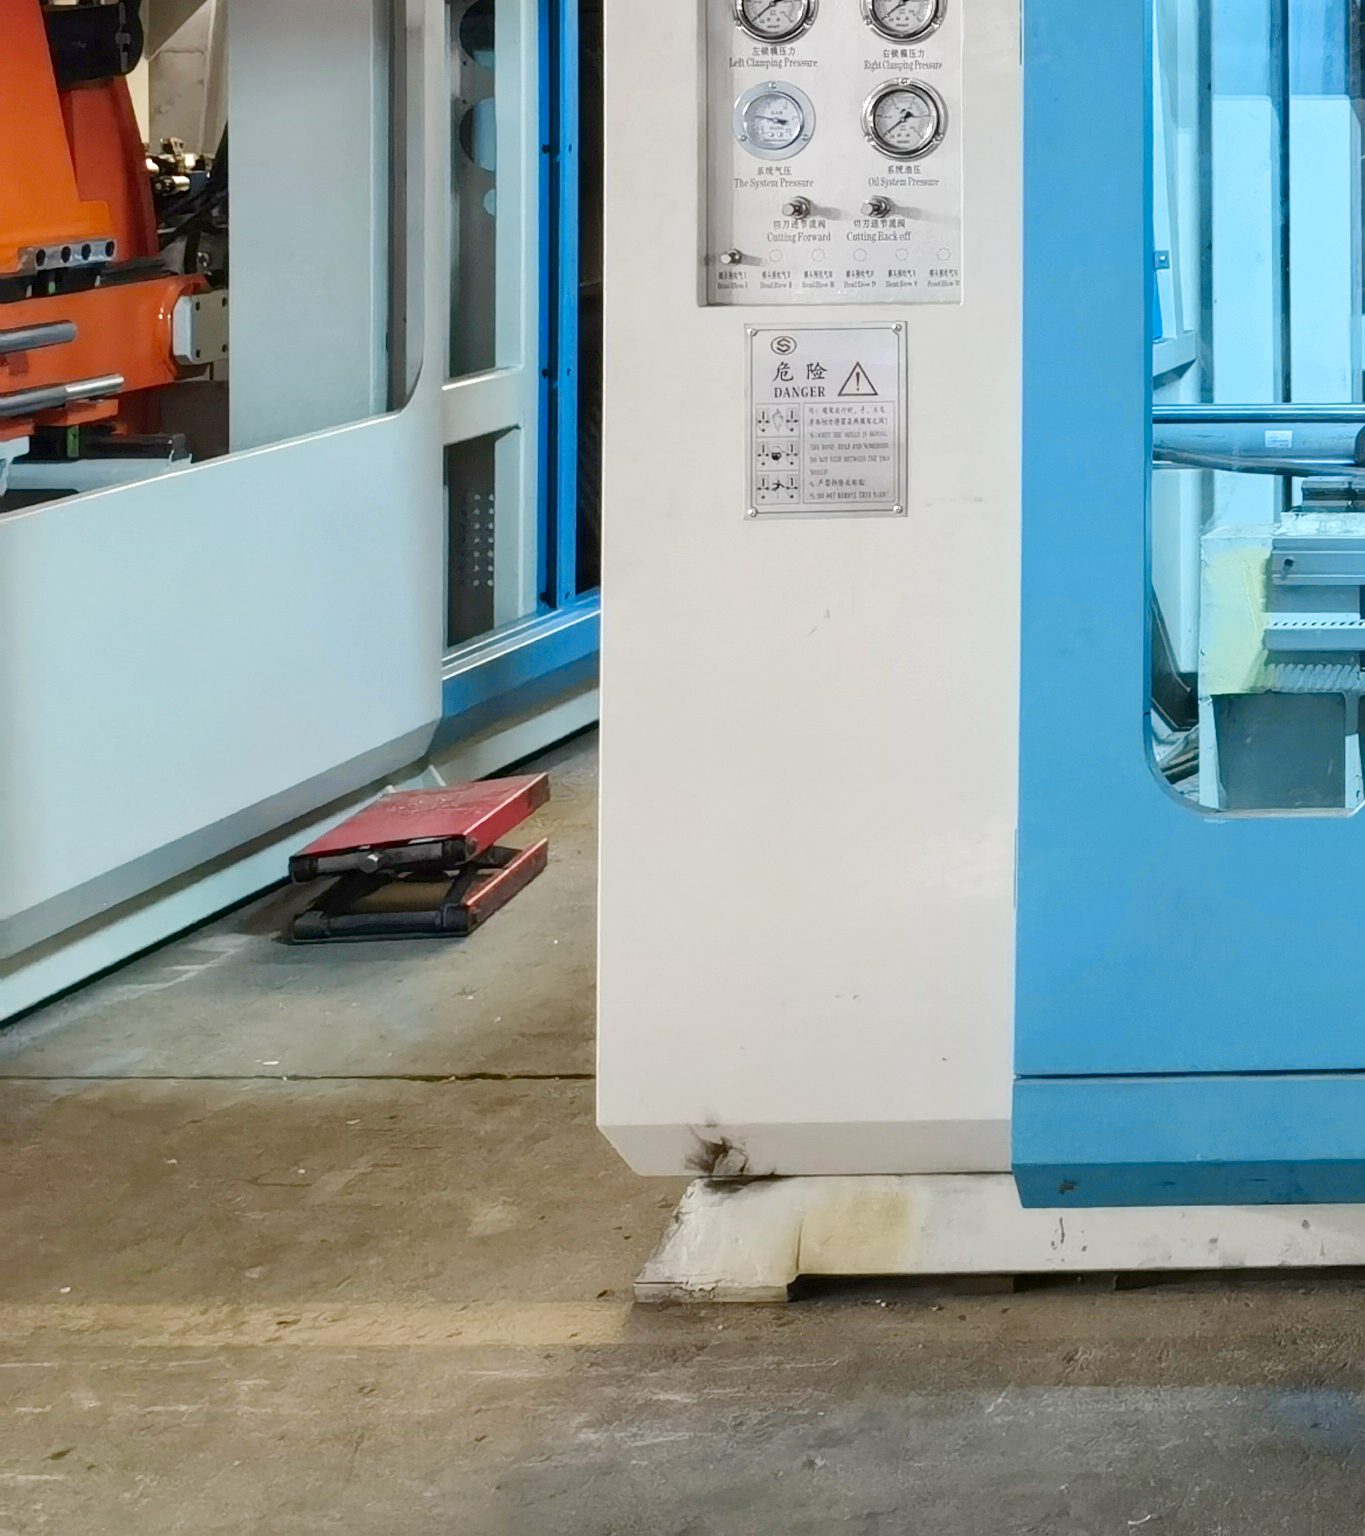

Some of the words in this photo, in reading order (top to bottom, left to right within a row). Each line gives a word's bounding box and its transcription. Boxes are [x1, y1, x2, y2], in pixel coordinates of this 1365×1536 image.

[729, 57, 745, 68] Left
[746, 58, 783, 70] Clamping
[784, 58, 818, 68] Pressure
[863, 60, 881, 71] Right
[882, 60, 913, 71] Clamping
[914, 61, 943, 70] Pressure
[734, 178, 749, 188] The
[750, 178, 778, 190] System
[780, 178, 814, 188] Pressure
[868, 177, 879, 186] Oil
[880, 178, 907, 188] System
[908, 177, 940, 186] Pressure
[767, 232, 796, 243] Cutting
[797, 232, 831, 242] Forward
[846, 231, 876, 243] Cutting
[878, 231, 898, 241] Back
[899, 231, 911, 241] off
[772, 361, 829, 383] 危险
[774, 386, 826, 398] DANGER
